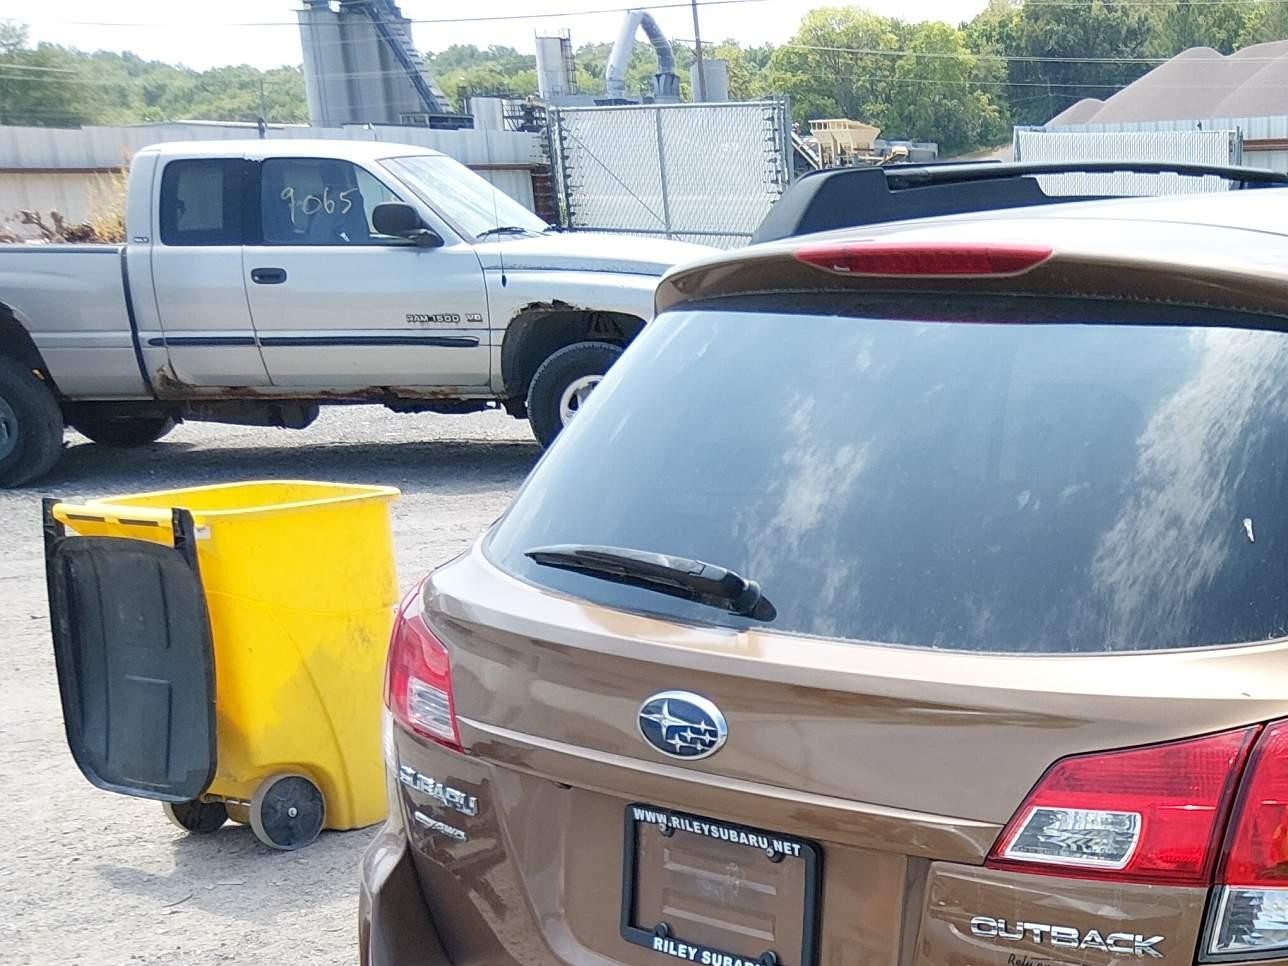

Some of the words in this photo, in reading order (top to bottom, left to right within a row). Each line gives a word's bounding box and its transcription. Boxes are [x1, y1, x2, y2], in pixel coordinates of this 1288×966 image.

[280, 186, 359, 226] 9065
[633, 807, 801, 857] WWW.RILEYSUBARU.NET
[652, 936, 698, 961] RILEY
[969, 915, 1165, 959] OUTBACK
